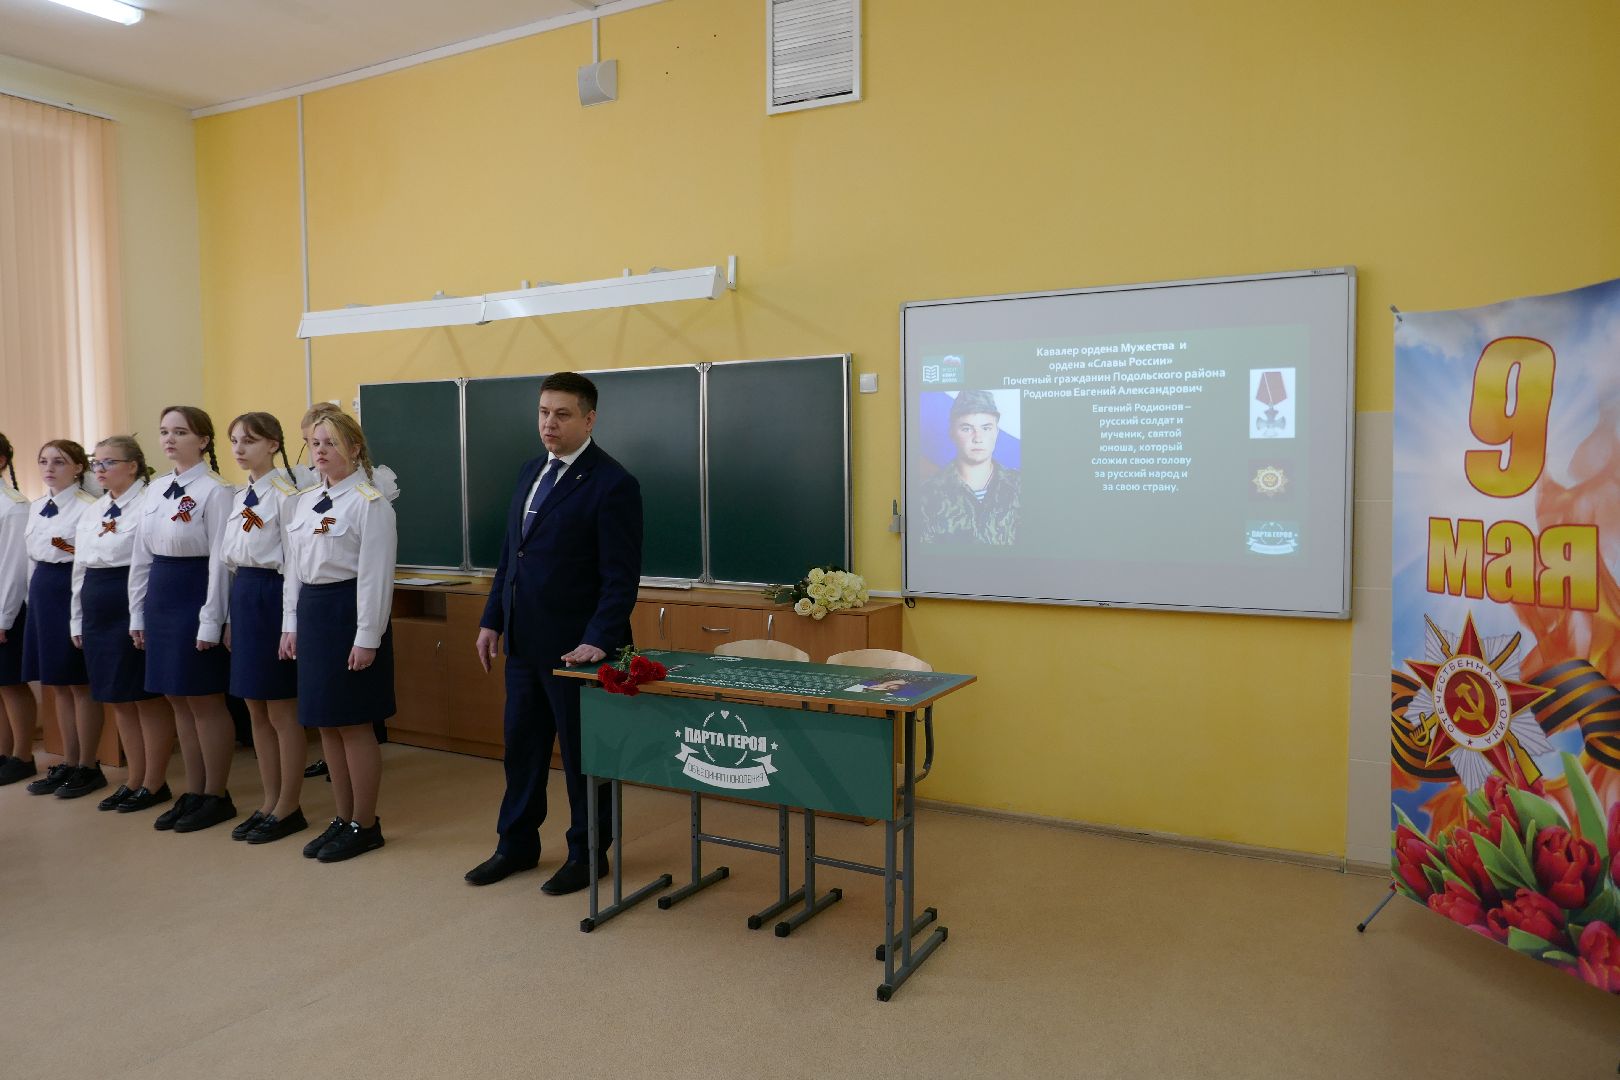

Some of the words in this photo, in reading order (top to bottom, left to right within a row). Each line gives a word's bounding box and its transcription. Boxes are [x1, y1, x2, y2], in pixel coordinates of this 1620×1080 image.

[1036, 347, 1079, 357] Кавалер
[1081, 345, 1118, 356] ордена
[1121, 342, 1175, 354] Мужества
[1179, 341, 1187, 350] и
[1049, 361, 1086, 372] ордена
[1087, 358, 1126, 368] «Славы
[1129, 357, 1173, 367] России»
[1003, 374, 1052, 385] Почетный
[1054, 373, 1111, 386] гражданин
[1113, 370, 1182, 382] Подольского
[1184, 368, 1226, 381] района
[1023, 389, 1072, 399] Родионов
[1073, 385, 1116, 397] Евгений
[1118, 385, 1203, 396] Александрович
[1092, 403, 1132, 413] Евгений
[1134, 403, 1184, 413] Родионов
[1099, 415, 1138, 428] русский
[1140, 417, 1175, 426] солдат
[1464, 336, 1556, 498] 9
[1100, 430, 1145, 441] мученик,
[1147, 428, 1182, 438] святой
[1099, 444, 1137, 454] юноша,
[1139, 441, 1183, 453] который
[1091, 457, 1128, 465] сложил
[1129, 457, 1155, 465] свою
[1156, 457, 1192, 467] голову
[1107, 469, 1147, 480] русский
[1148, 470, 1180, 480] народ
[1181, 470, 1188, 478] и
[1142, 484, 1179, 493] страну.
[684, 726, 726, 747] ПАРТА
[727, 733, 767, 753] ГЕРОЯ
